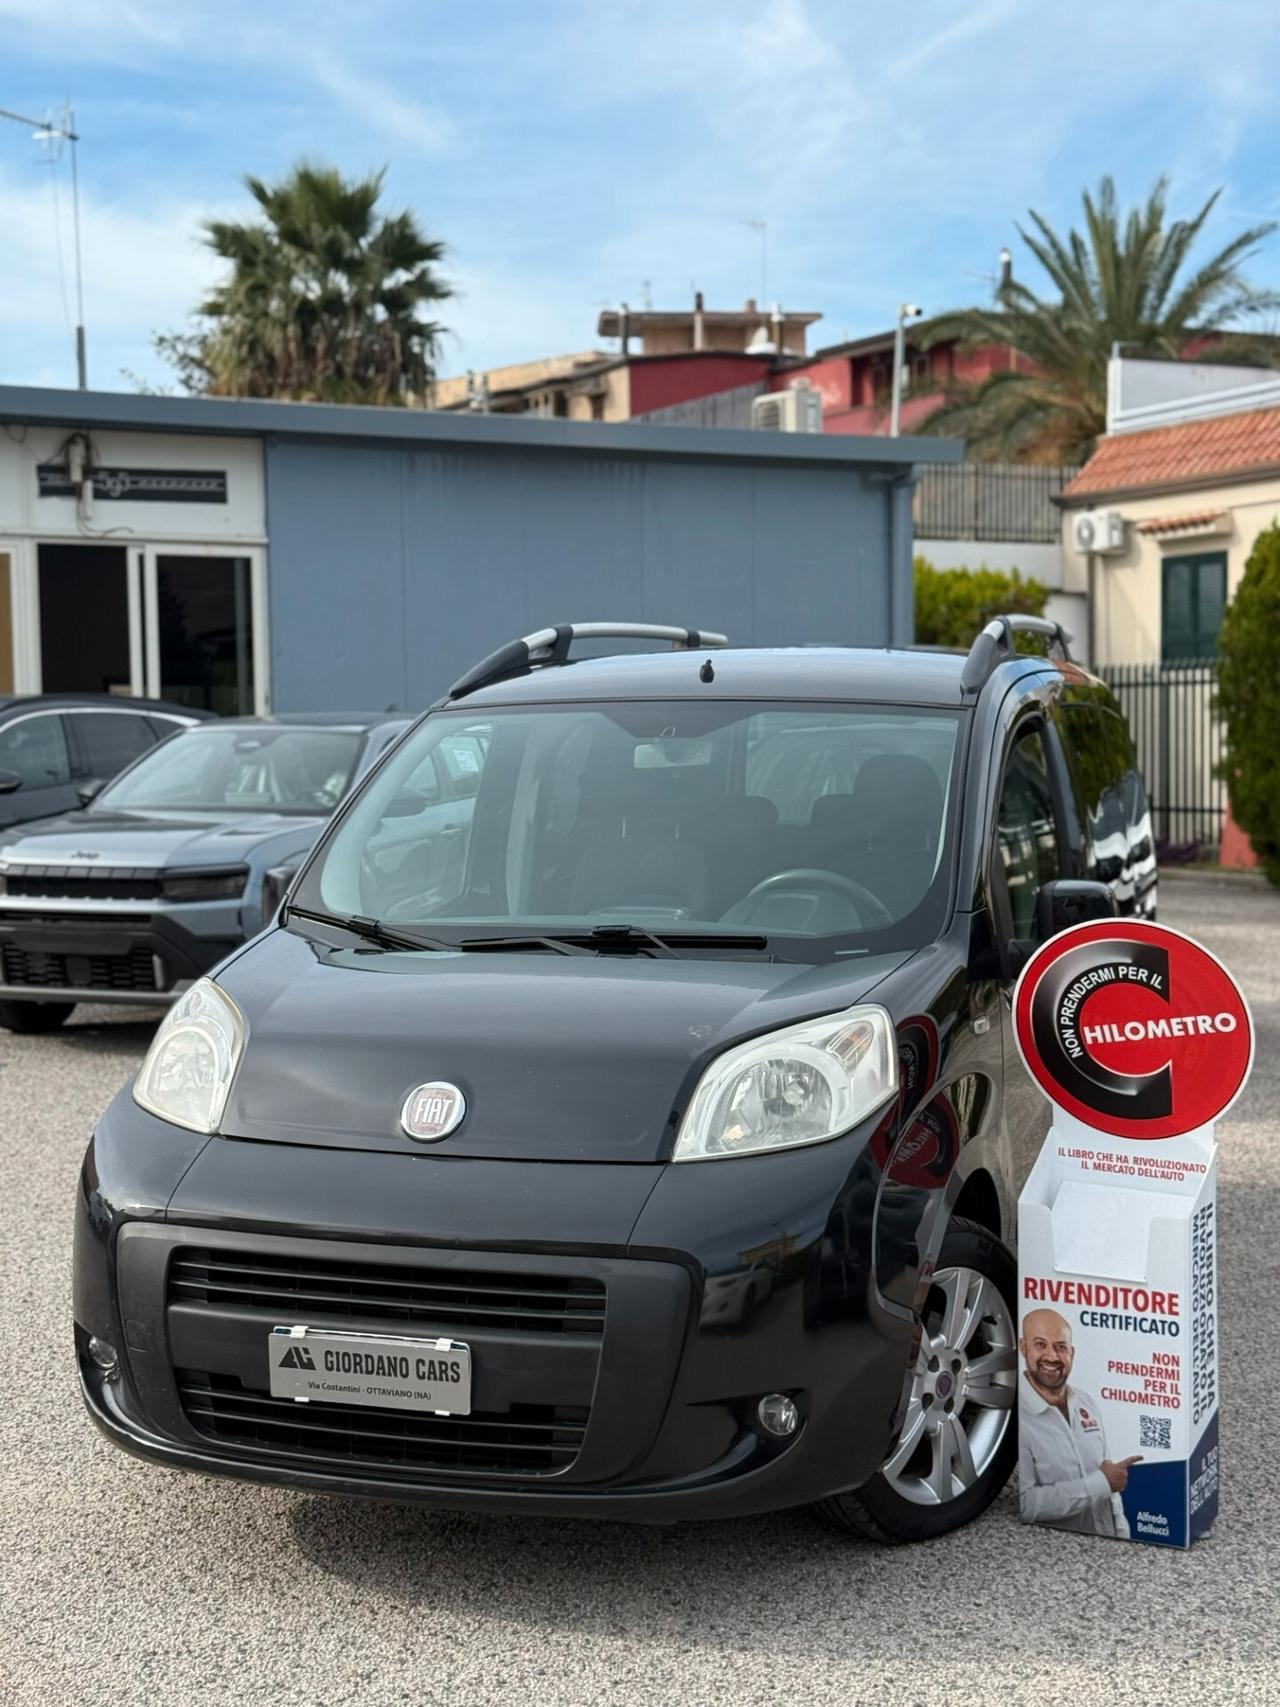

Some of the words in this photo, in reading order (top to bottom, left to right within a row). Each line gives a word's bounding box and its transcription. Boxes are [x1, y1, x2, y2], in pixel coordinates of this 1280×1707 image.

[1118, 966, 1148, 981] PER
[1150, 973, 1163, 989] IL
[1060, 967, 1115, 1025] PRENDERMI
[1061, 1029, 1083, 1059] NON
[414, 1097, 453, 1125] FIAT
[1058, 1147, 1066, 1157] IL
[1068, 1148, 1094, 1160] LIBRO
[1096, 1151, 1114, 1162] CHE
[1116, 1154, 1129, 1165] HA
[1133, 1156, 1207, 1174] RIVOLUZIONATO
[1081, 1160, 1089, 1170] IL
[1093, 1162, 1136, 1176] MERCATO
[1137, 1167, 1185, 1181] DELL'AUTO
[1024, 1277, 1180, 1316] RIVENDITORE
[1080, 1311, 1180, 1337] CERTIFICATO
[324, 1350, 409, 1379] GIORDANO
[416, 1358, 460, 1383] CARS
[1152, 1352, 1180, 1367] NON
[1107, 1360, 1180, 1381] PRENDERMI
[308, 1381, 320, 1390] Via
[322, 1382, 361, 1394] Costantini
[366, 1386, 413, 1399] OTTAVIANO
[414, 1390, 432, 1400] (NA)
[1144, 1379, 1167, 1393] PER
[1170, 1382, 1181, 1395] IL
[1101, 1387, 1180, 1409] CHILOMETRO
[1137, 1511, 1168, 1525] Alfredo
[1137, 1522, 1170, 1536] Bellucci
